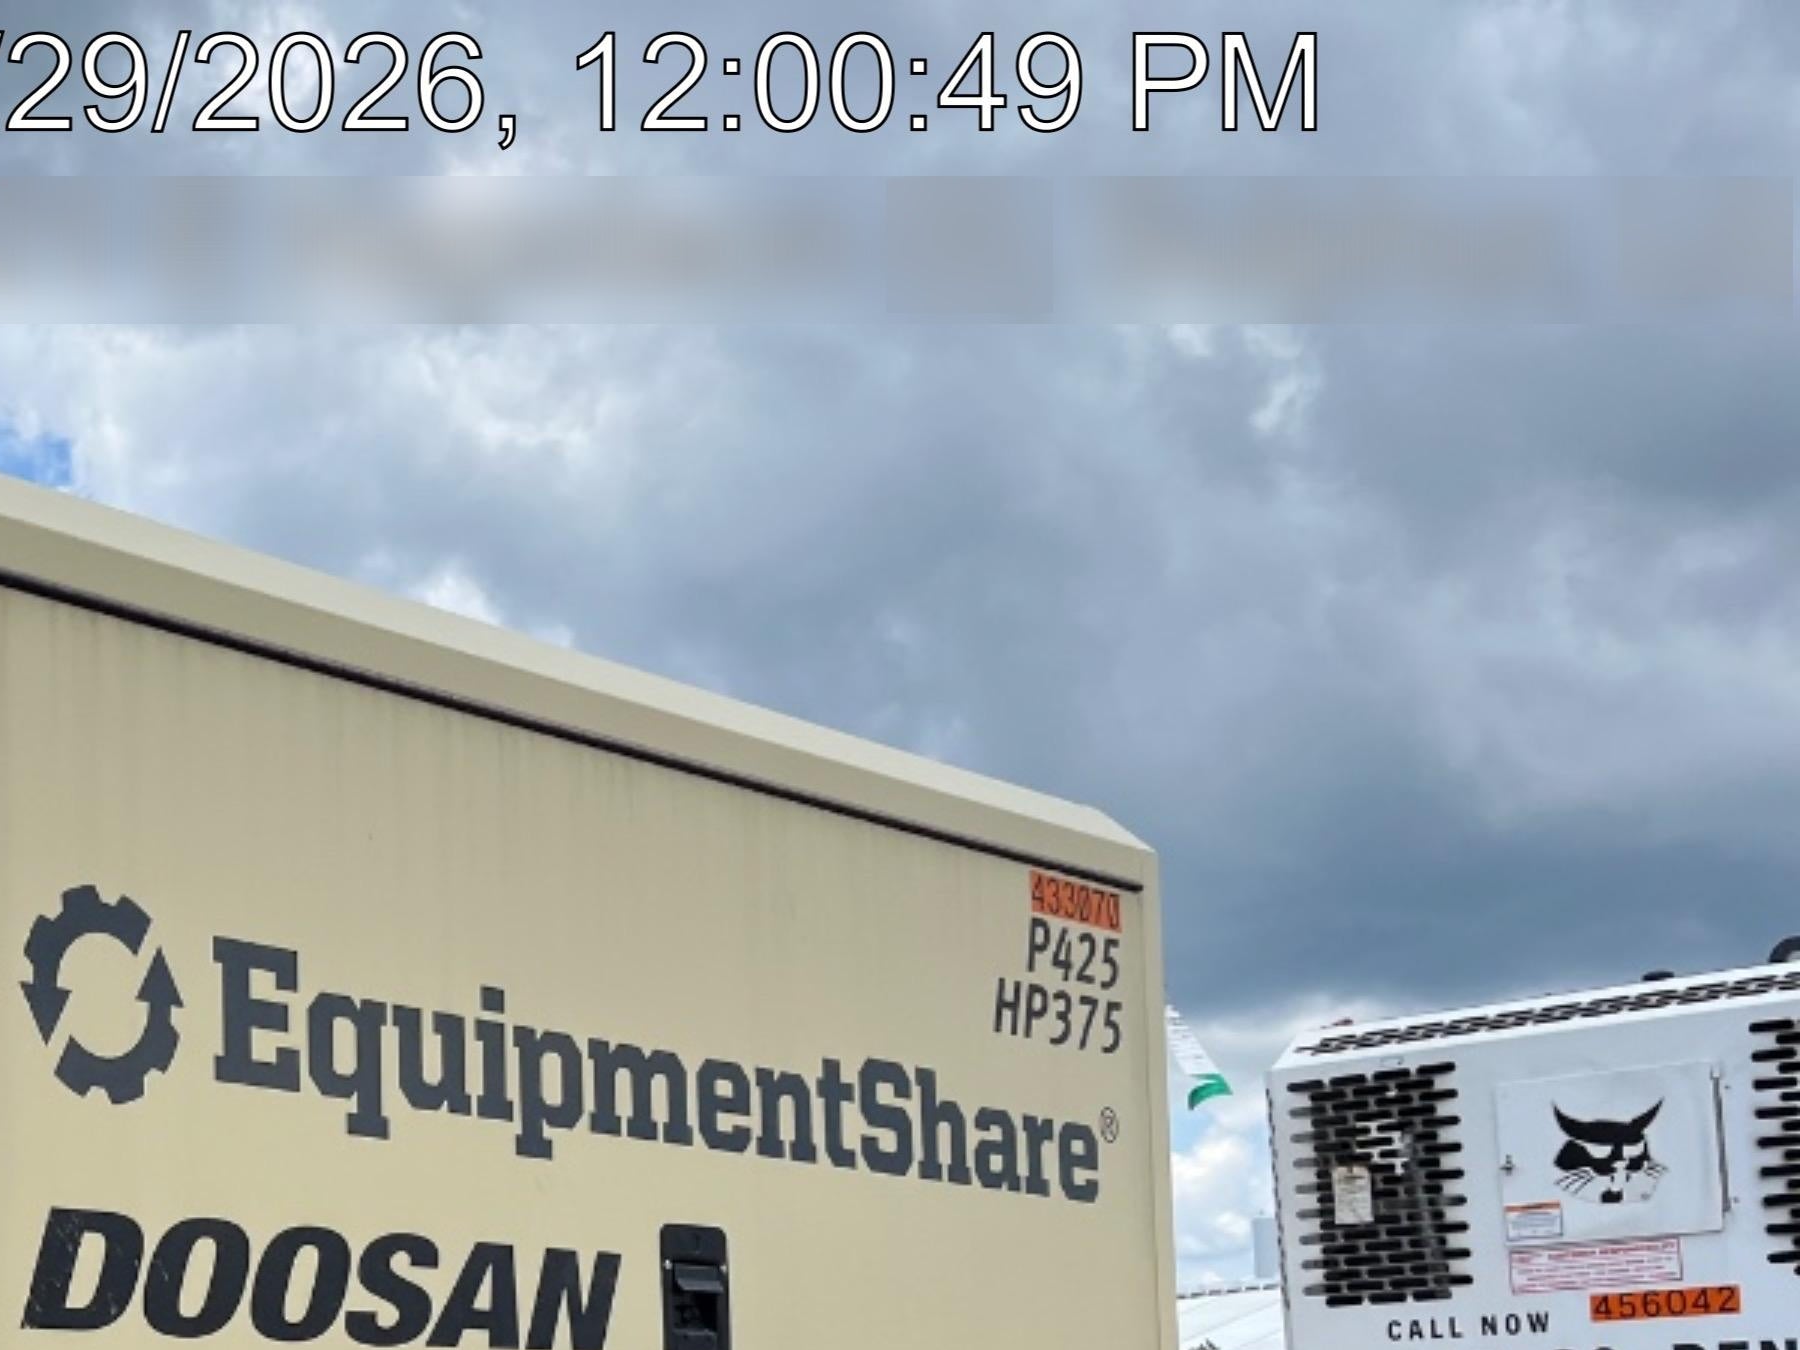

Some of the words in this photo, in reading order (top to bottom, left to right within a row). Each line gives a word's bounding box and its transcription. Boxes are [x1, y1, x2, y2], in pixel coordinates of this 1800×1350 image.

[1031, 876, 1121, 932] 433070
[1026, 916, 1121, 990] P425
[993, 977, 1123, 1054] HP375
[1387, 1316, 1464, 1341] CALL
[1480, 1311, 1551, 1337] NOW
[1593, 1286, 1739, 1319] 456042
